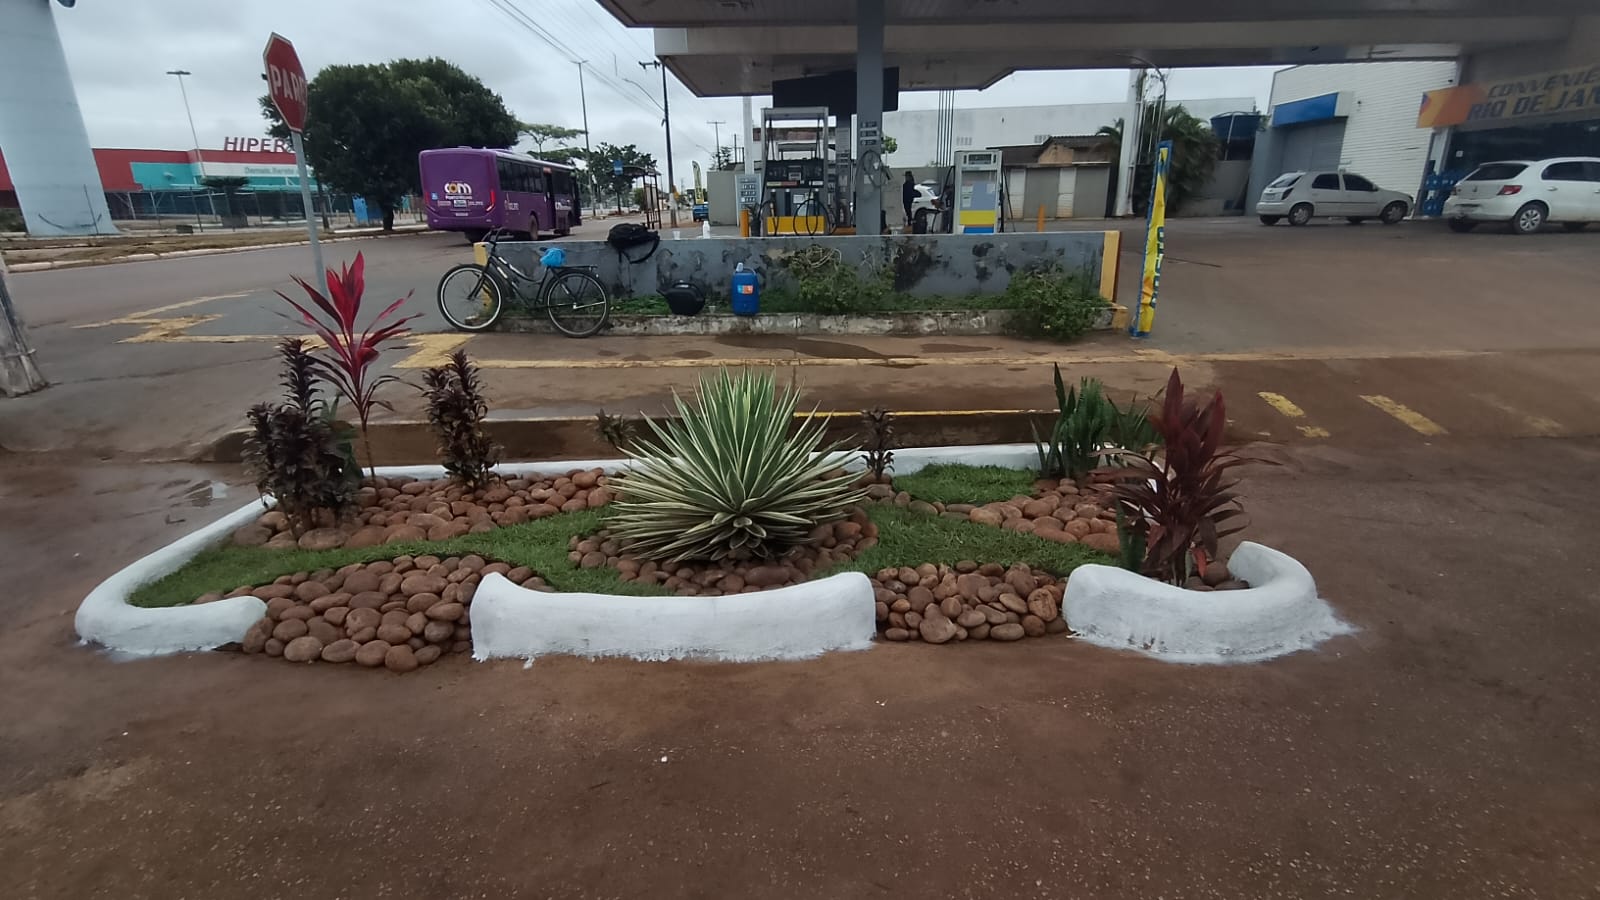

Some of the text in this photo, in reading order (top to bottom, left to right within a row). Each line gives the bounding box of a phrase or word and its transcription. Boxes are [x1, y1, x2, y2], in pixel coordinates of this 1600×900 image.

[1467, 101, 1507, 120] RIO
[1512, 95, 1544, 115] DE
[224, 136, 287, 153] HIPER
